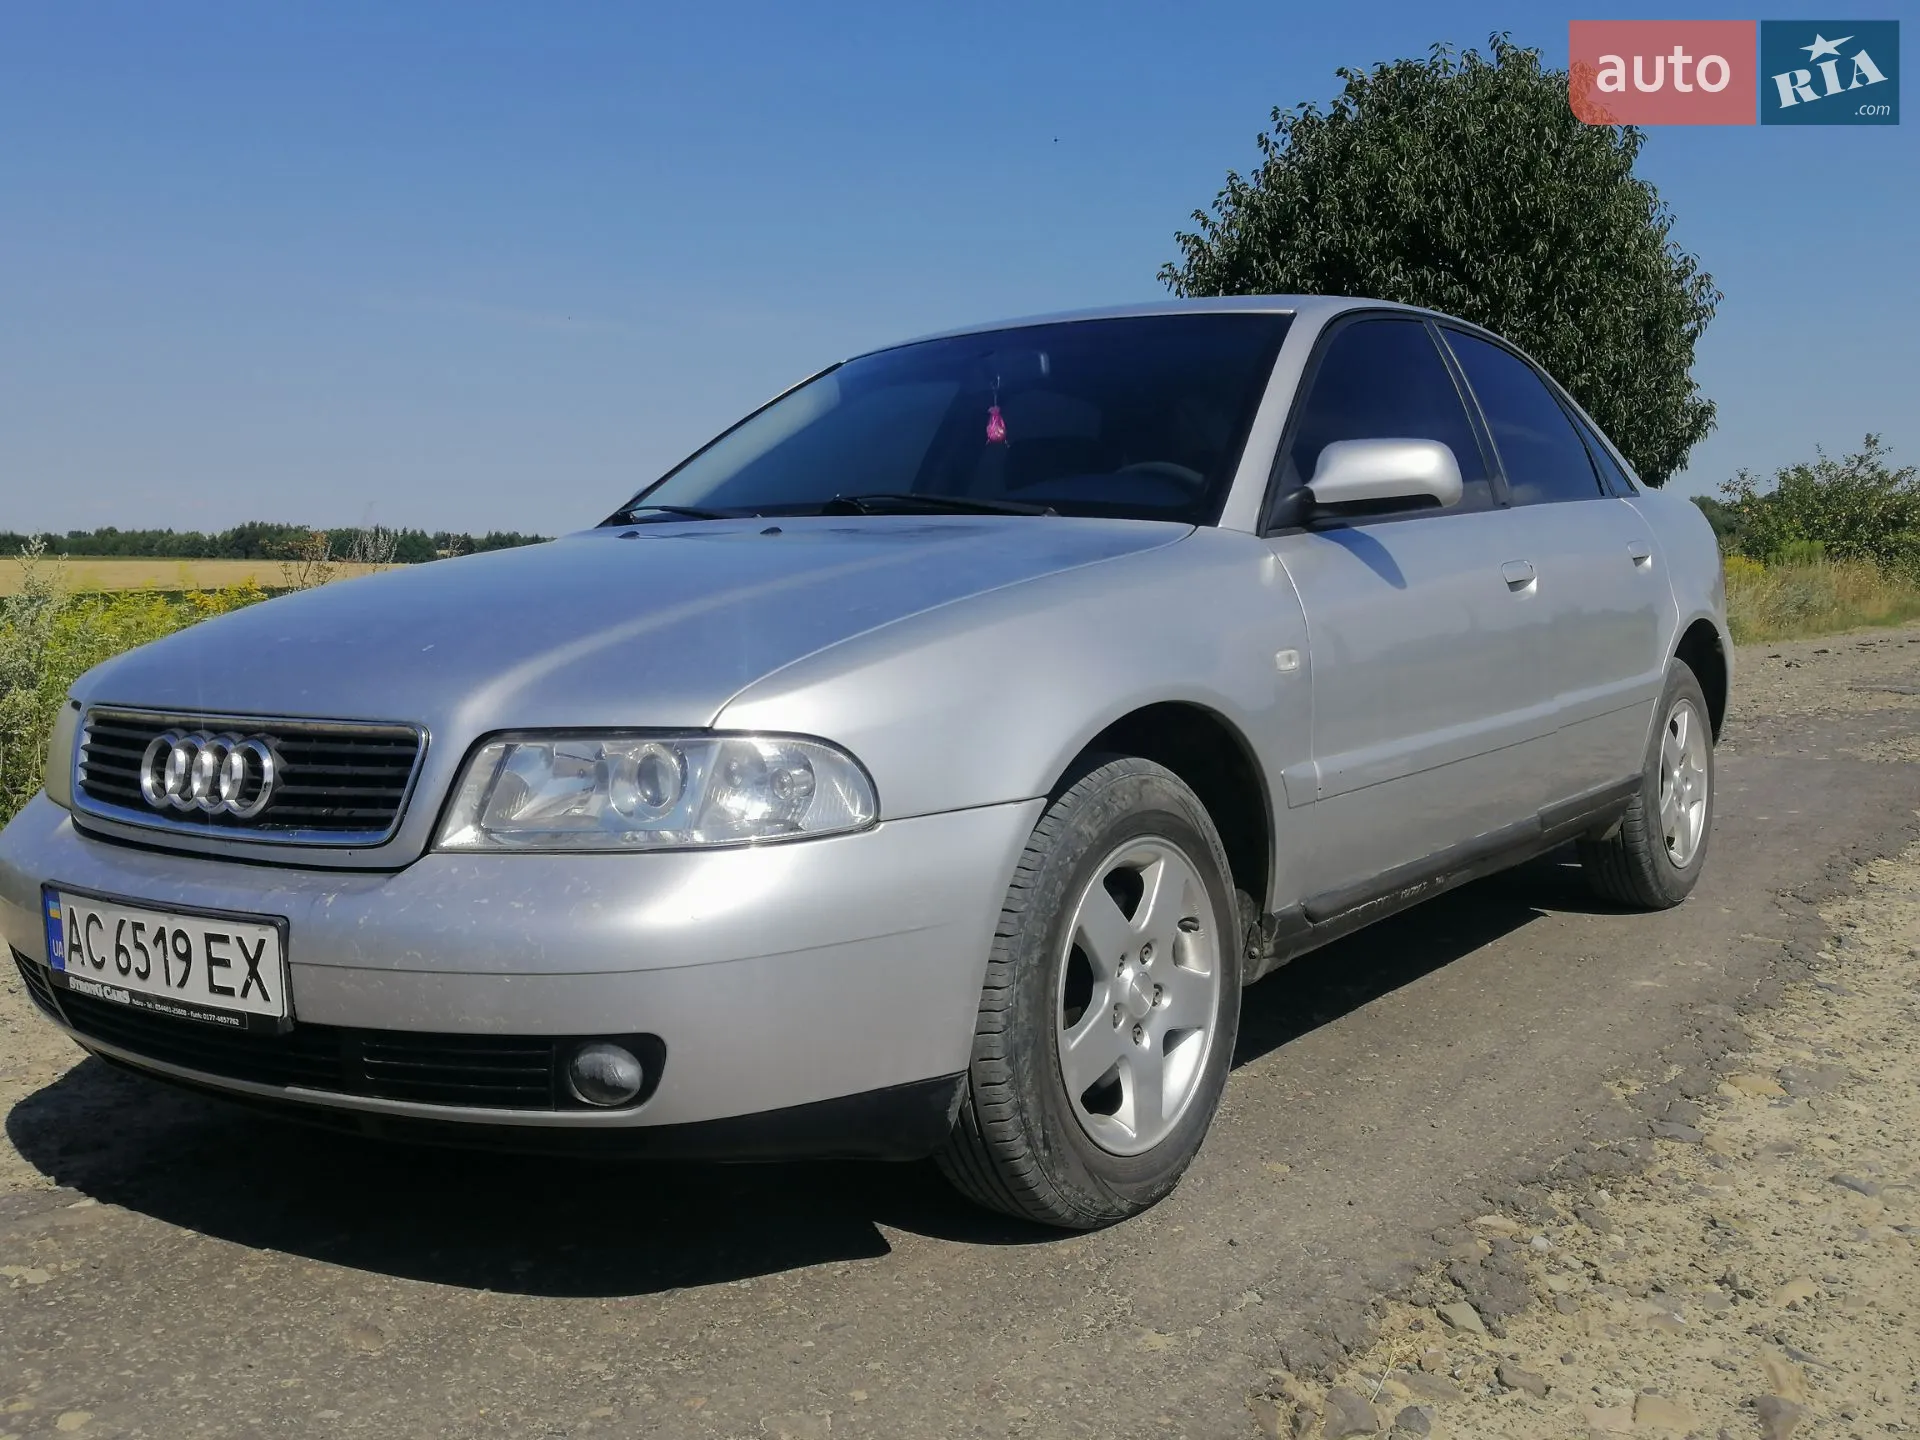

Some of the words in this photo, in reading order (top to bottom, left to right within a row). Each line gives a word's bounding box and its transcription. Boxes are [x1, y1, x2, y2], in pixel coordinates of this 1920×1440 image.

[52, 939, 64, 957] UA
[68, 906, 106, 970] AC
[115, 918, 192, 989] 6519
[204, 932, 271, 1002] EX
